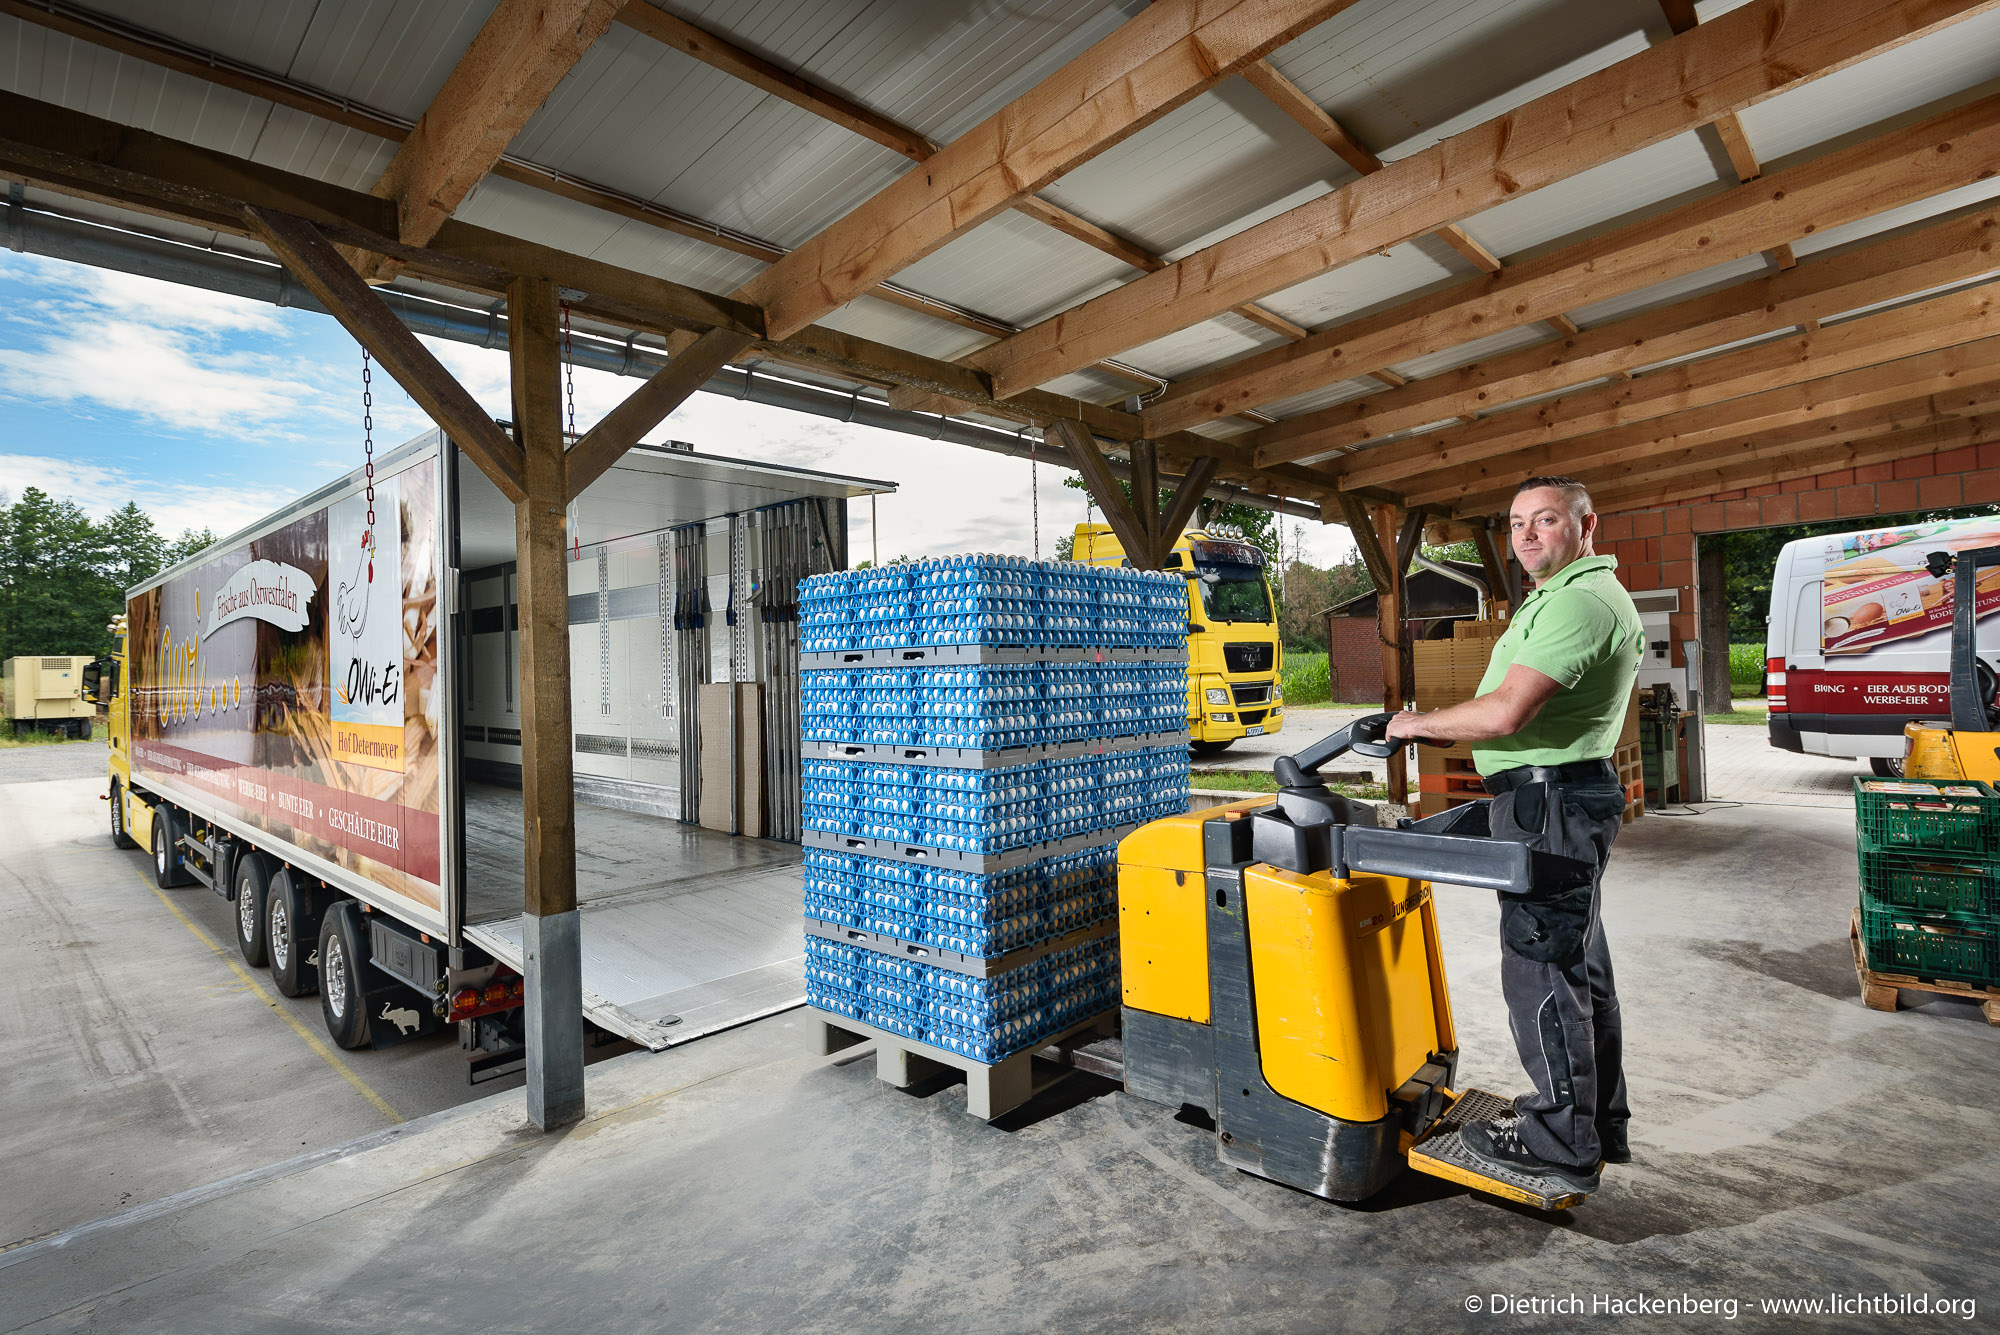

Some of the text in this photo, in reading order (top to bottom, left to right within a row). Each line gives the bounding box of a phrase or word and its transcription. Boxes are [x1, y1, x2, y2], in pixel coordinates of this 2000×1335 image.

[217, 576, 297, 620] Frische aus Ostwestfalen
[1863, 696, 1929, 705] WERBE-EIER
[1867, 685, 1889, 693] EIER
[1892, 685, 1916, 693] AUS
[338, 731, 399, 760] Hof Determeyer
[278, 791, 299, 814] BUNTE
[299, 798, 314, 820] EIER
[328, 807, 377, 842] GESCHÄLTE
[377, 823, 400, 850] EIER
